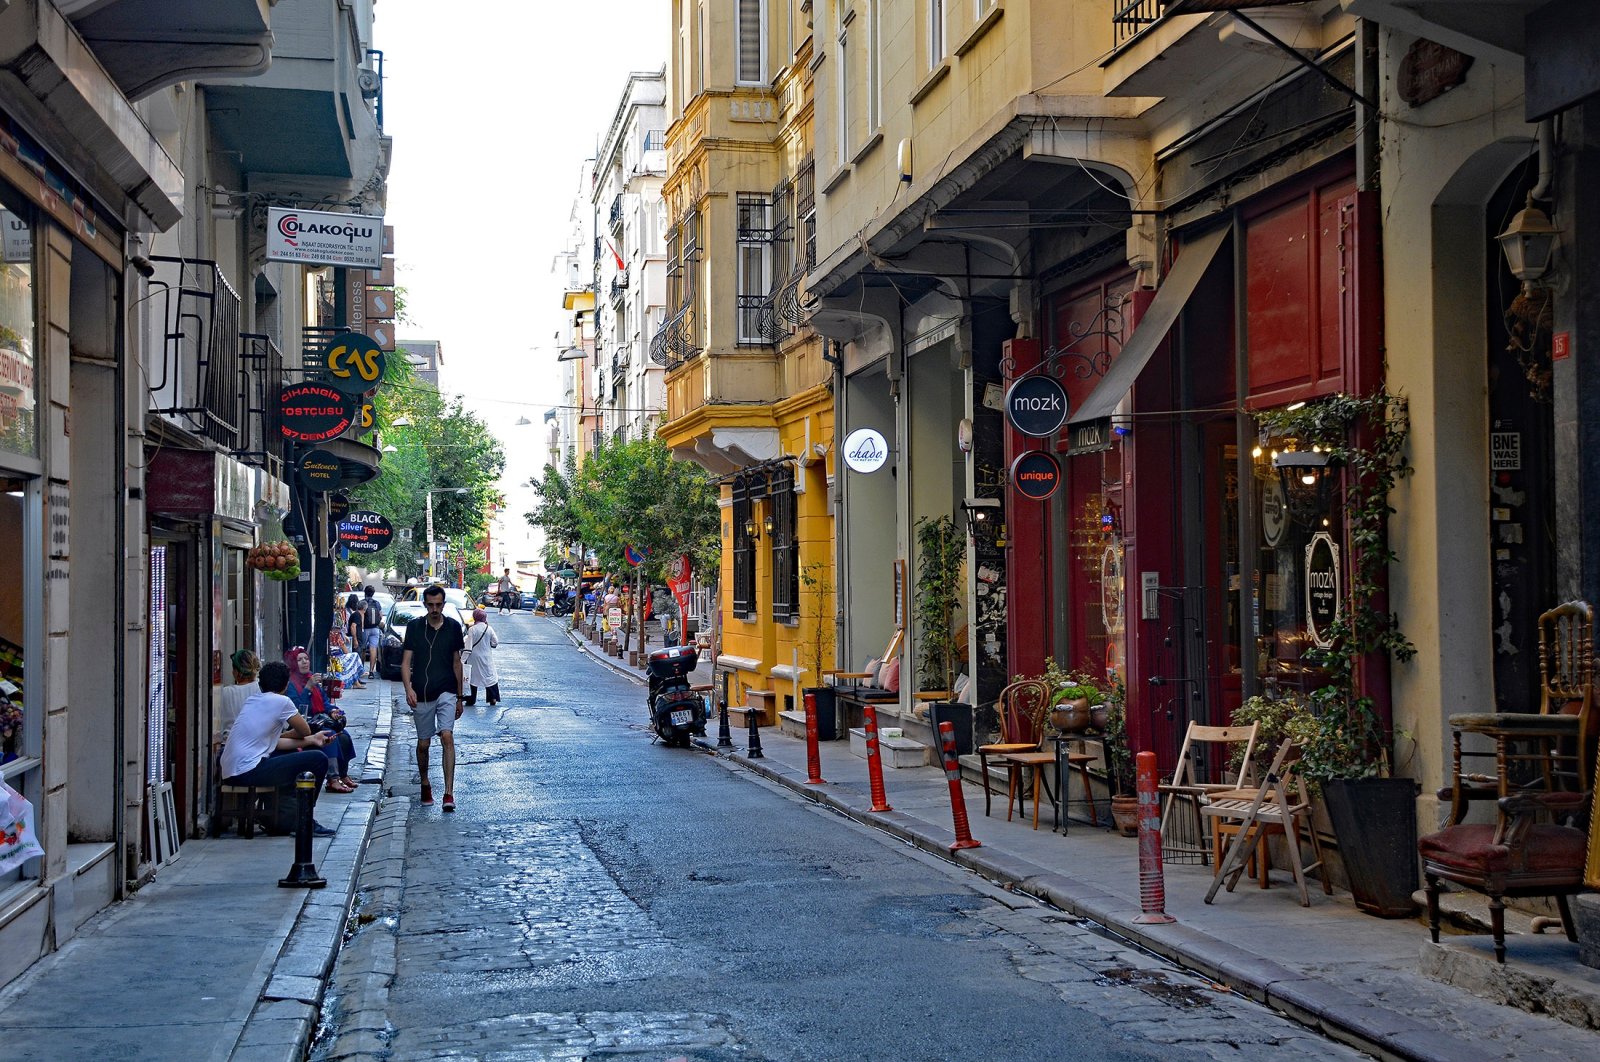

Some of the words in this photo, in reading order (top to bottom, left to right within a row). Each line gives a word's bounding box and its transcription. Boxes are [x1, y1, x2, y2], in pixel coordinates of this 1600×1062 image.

[1014, 393, 1061, 411] mozk
[1492, 434, 1519, 450] BNE
[1493, 450, 1519, 459] WAS
[1493, 459, 1519, 468] HERE
[1020, 470, 1054, 482] unique
[350, 513, 381, 524] BLACK
[340, 522, 363, 531] Silver
[363, 526, 390, 536] Tattoo
[350, 541, 378, 550] Piercing
[1310, 566, 1335, 589] mozk
